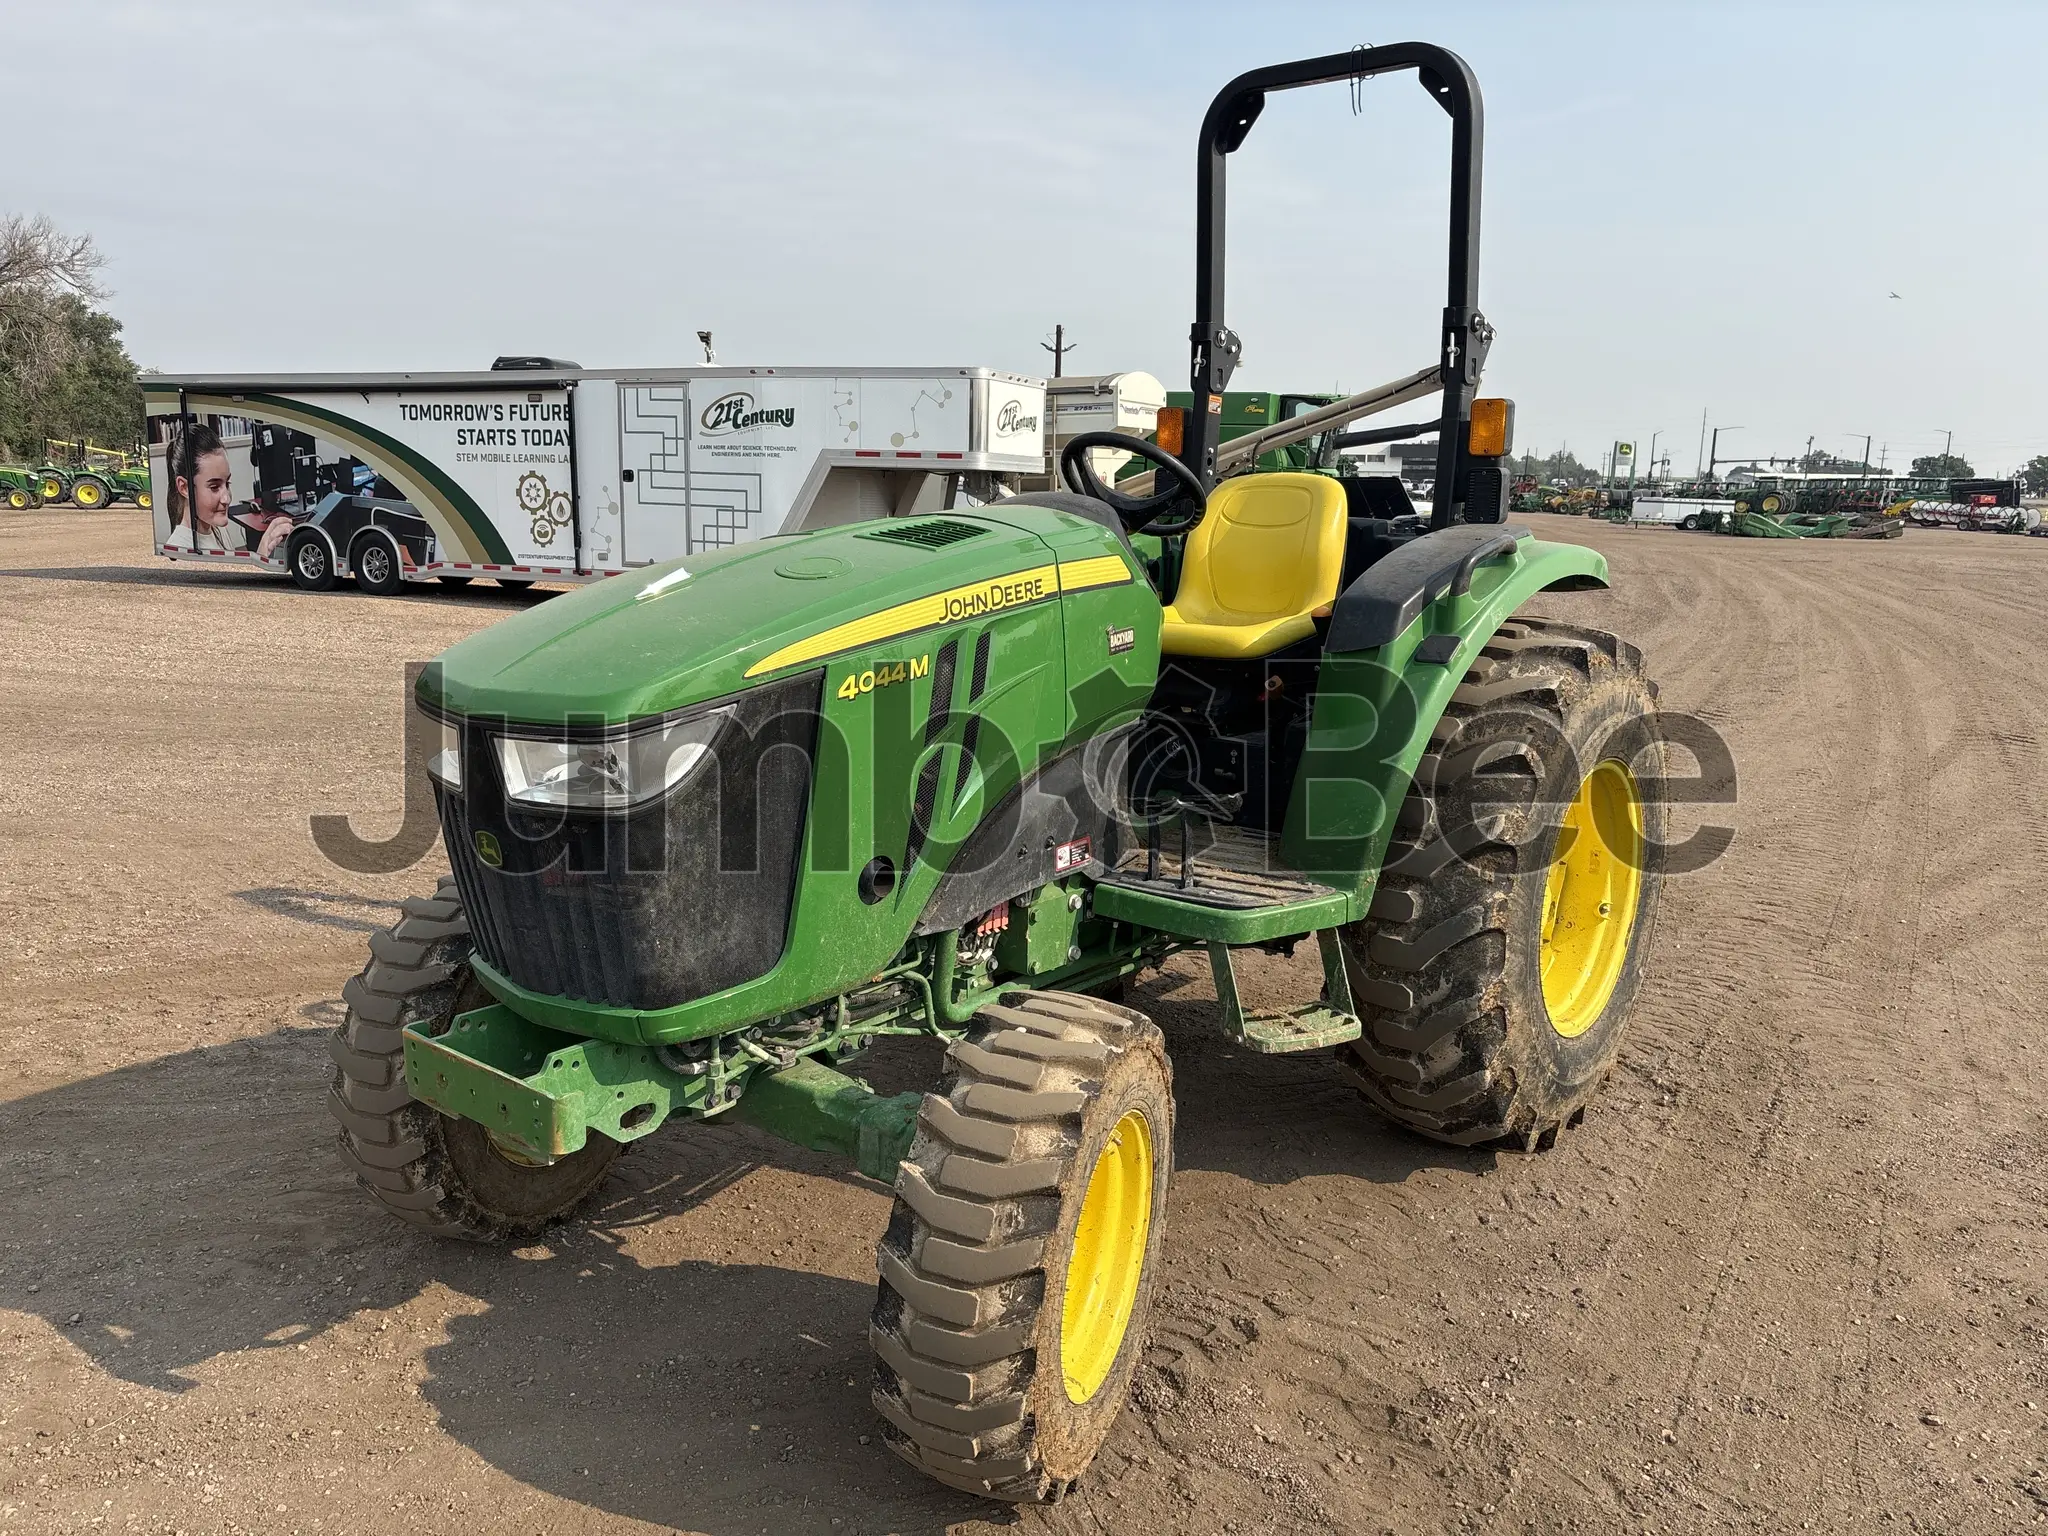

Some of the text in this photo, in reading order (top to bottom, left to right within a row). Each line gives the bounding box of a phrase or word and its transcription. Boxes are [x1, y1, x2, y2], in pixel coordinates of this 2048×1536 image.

[399, 404, 570, 421] TOMORROW'S FUTURE
[709, 397, 745, 430] 21st
[457, 428, 517, 446] STARTS
[456, 453, 570, 464] STEM MOBILE LEARNING LA
[939, 578, 1043, 621] JOHN DEERE
